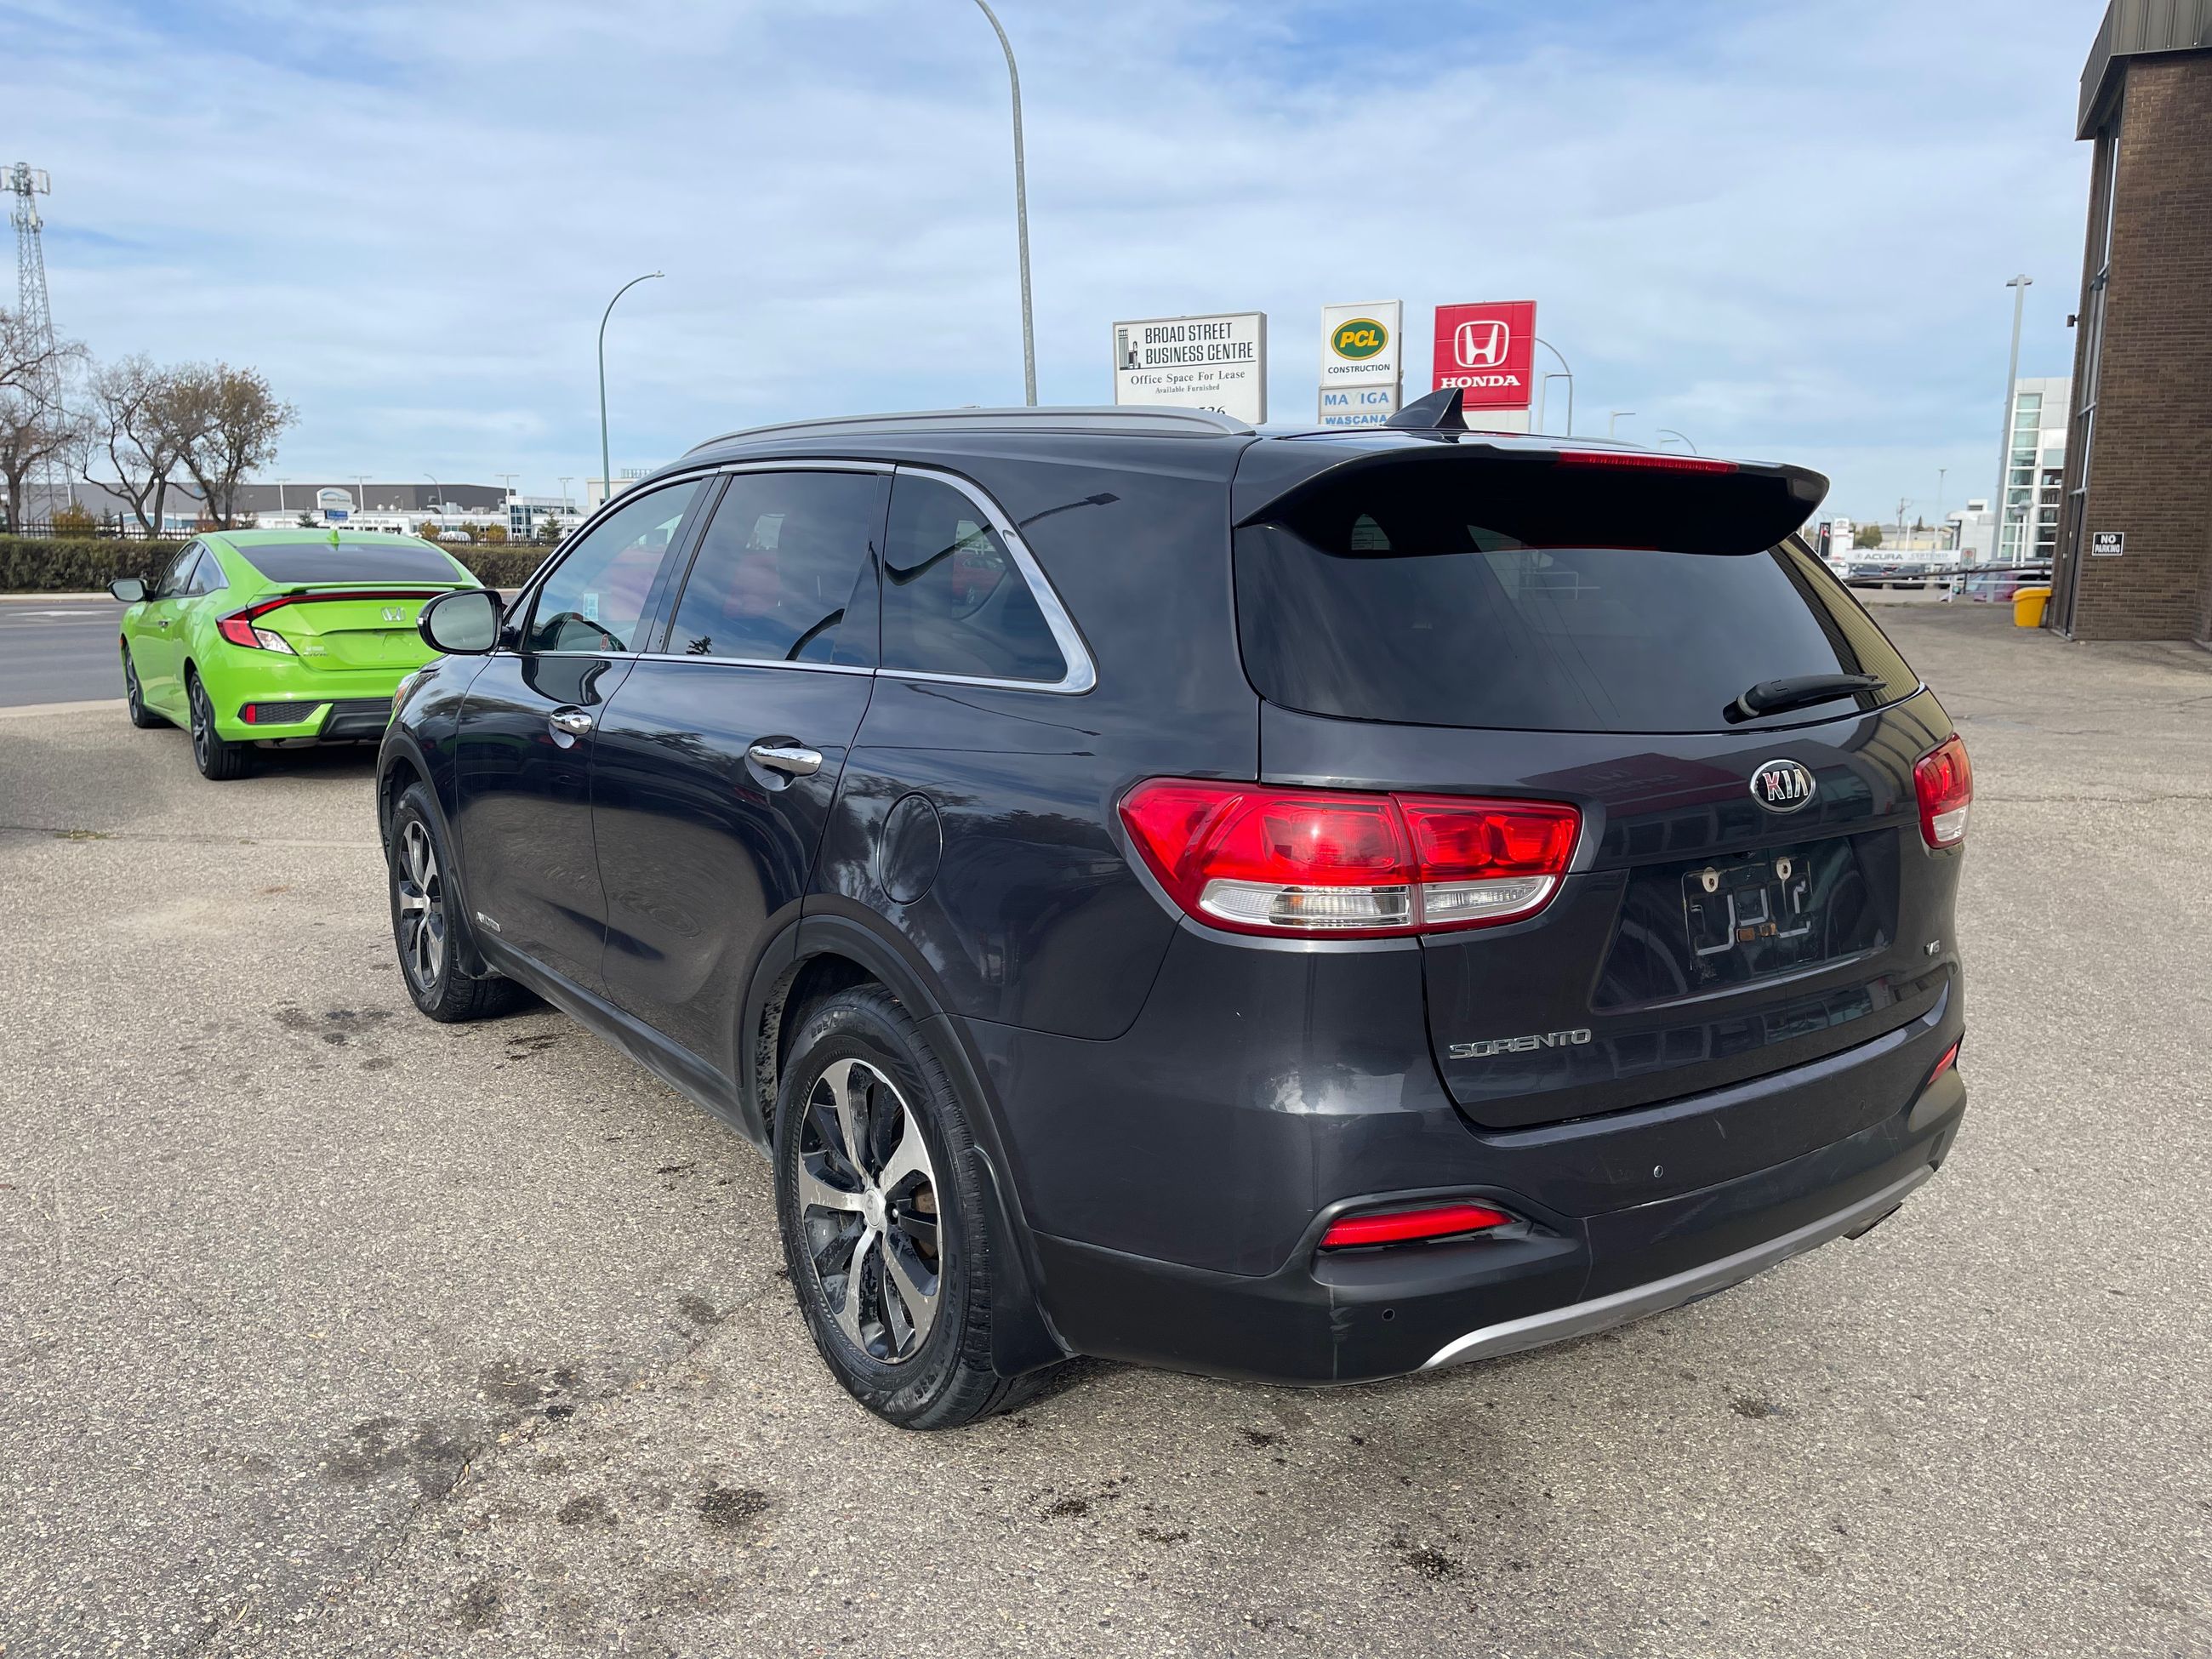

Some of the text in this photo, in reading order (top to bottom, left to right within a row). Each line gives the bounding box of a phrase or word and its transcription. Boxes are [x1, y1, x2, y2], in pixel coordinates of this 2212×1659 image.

[1145, 322, 1233, 345] BROAD STREET
[1340, 329, 1379, 348] PCL
[1146, 341, 1253, 364] BUSINESS CENTRE
[1327, 363, 1390, 373] CONSTRUCTION
[1131, 369, 1246, 385] Office Space For Lease
[1440, 374, 1521, 389] HONDA
[1155, 384, 1220, 394] Available Furnished
[1325, 414, 1387, 425] WASCANA
[2101, 534, 2117, 544] NO
[2095, 544, 2121, 553] PARKING
[1762, 769, 1808, 801] KIA
[1449, 1028, 1592, 1060] SORENTO
